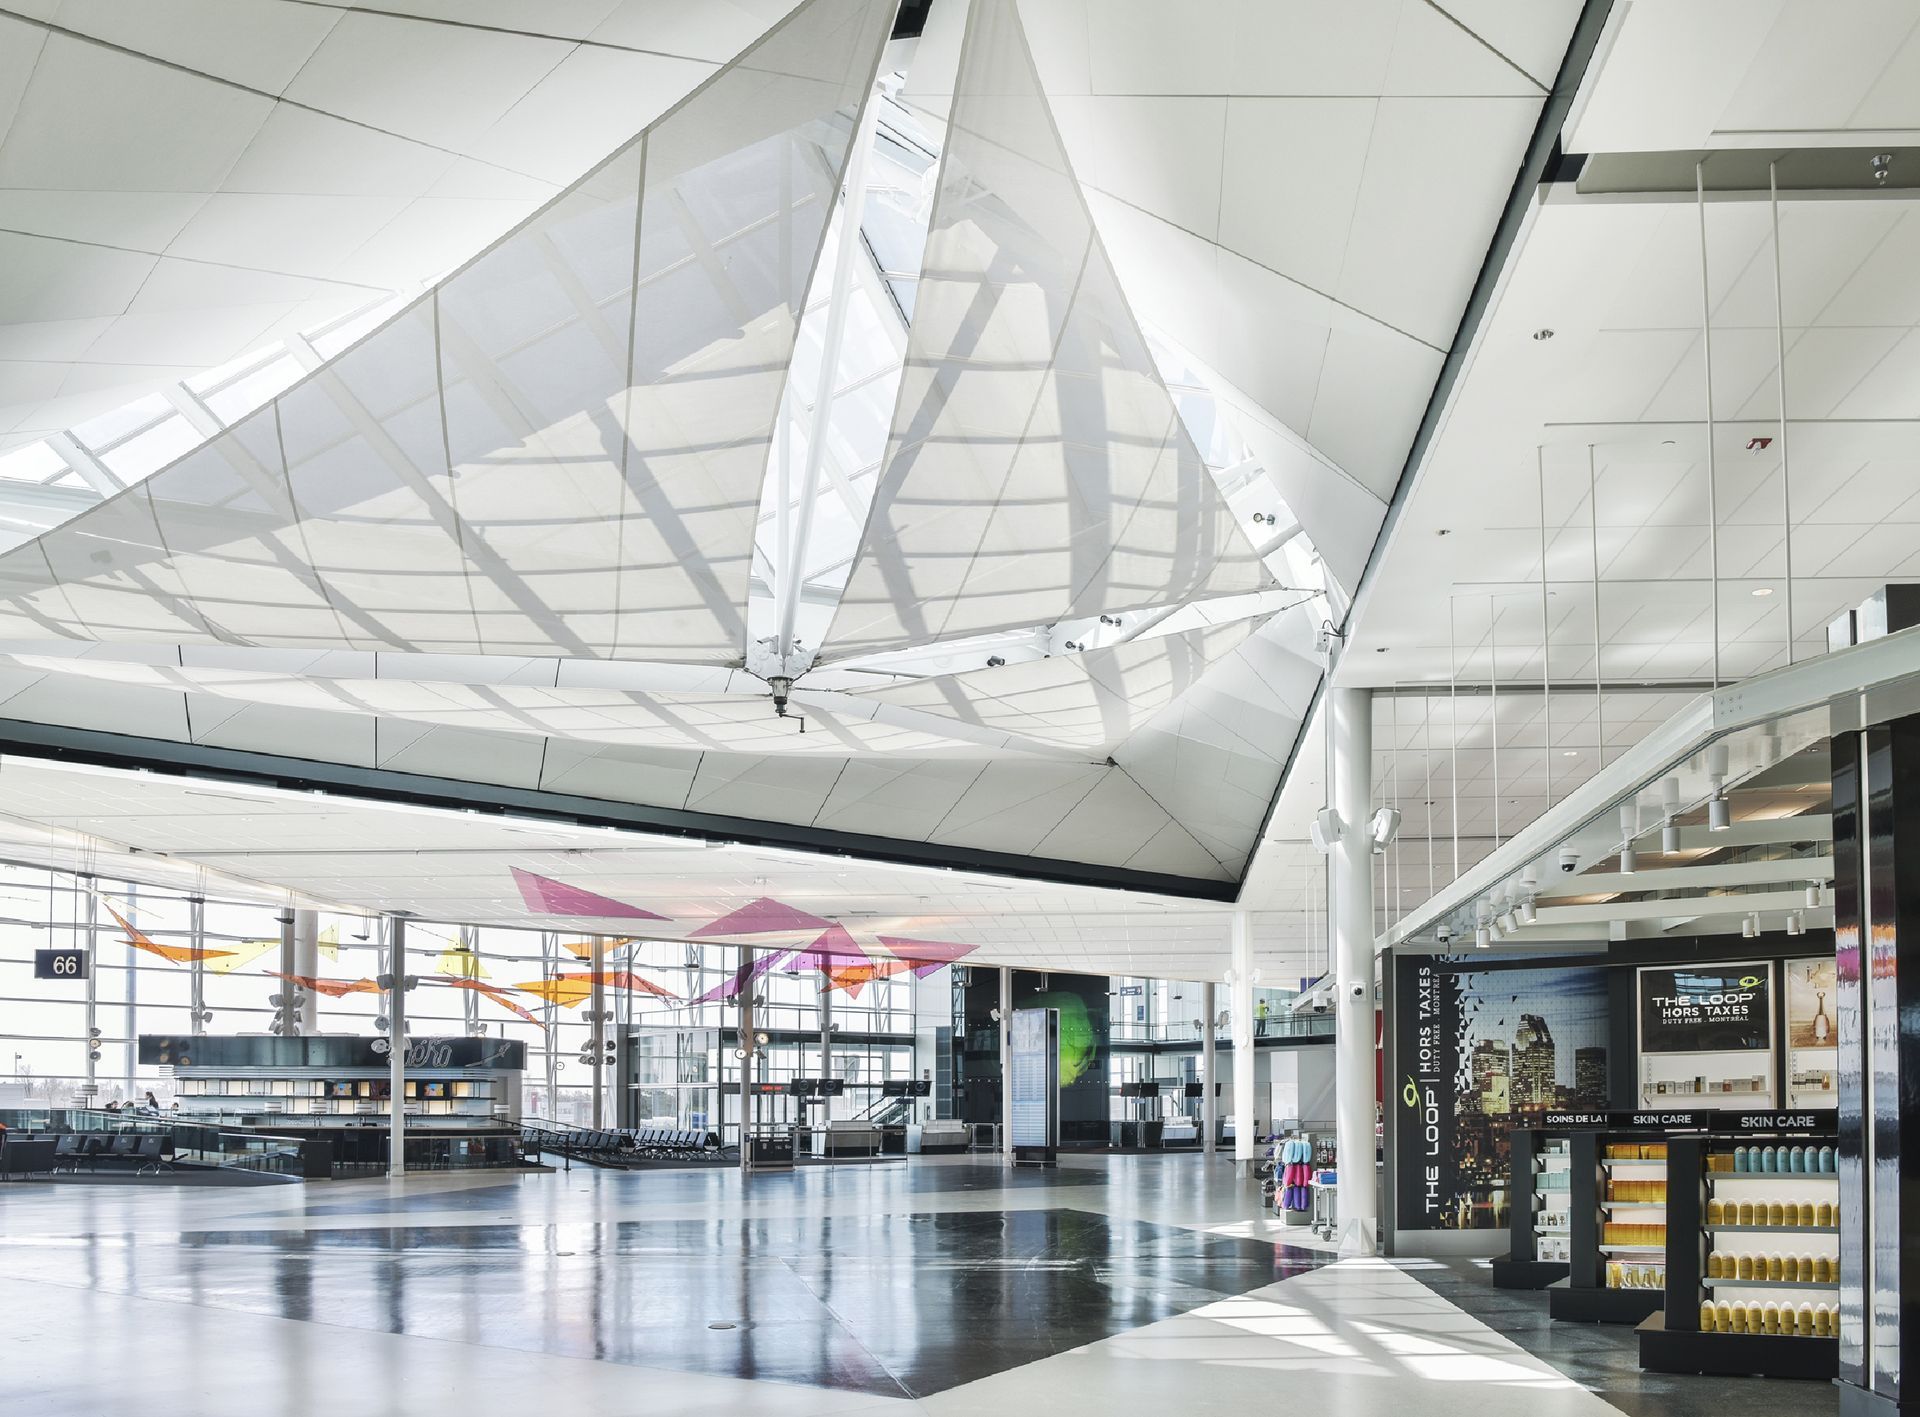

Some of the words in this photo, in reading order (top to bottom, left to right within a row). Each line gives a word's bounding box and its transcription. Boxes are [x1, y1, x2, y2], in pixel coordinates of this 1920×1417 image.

[53, 955, 77, 975] 66
[1419, 967, 1432, 1020] TAXES
[1651, 995, 1691, 1007] THE
[1699, 993, 1754, 1006] LOOP
[1662, 1007, 1700, 1018] HORS
[1704, 1005, 1749, 1016] TAXES
[1419, 1026, 1432, 1073] HORS
[1425, 1089, 1439, 1155] LOOP
[1546, 1115, 1575, 1124] SOINS
[1575, 1115, 1589, 1123] DE
[1590, 1114, 1603, 1123] LA
[1633, 1115, 1659, 1124] SKIN
[1661, 1114, 1692, 1124] CARE
[1741, 1116, 1773, 1128] SKIN
[1776, 1116, 1815, 1127] CARE
[1425, 1166, 1439, 1214] THE
